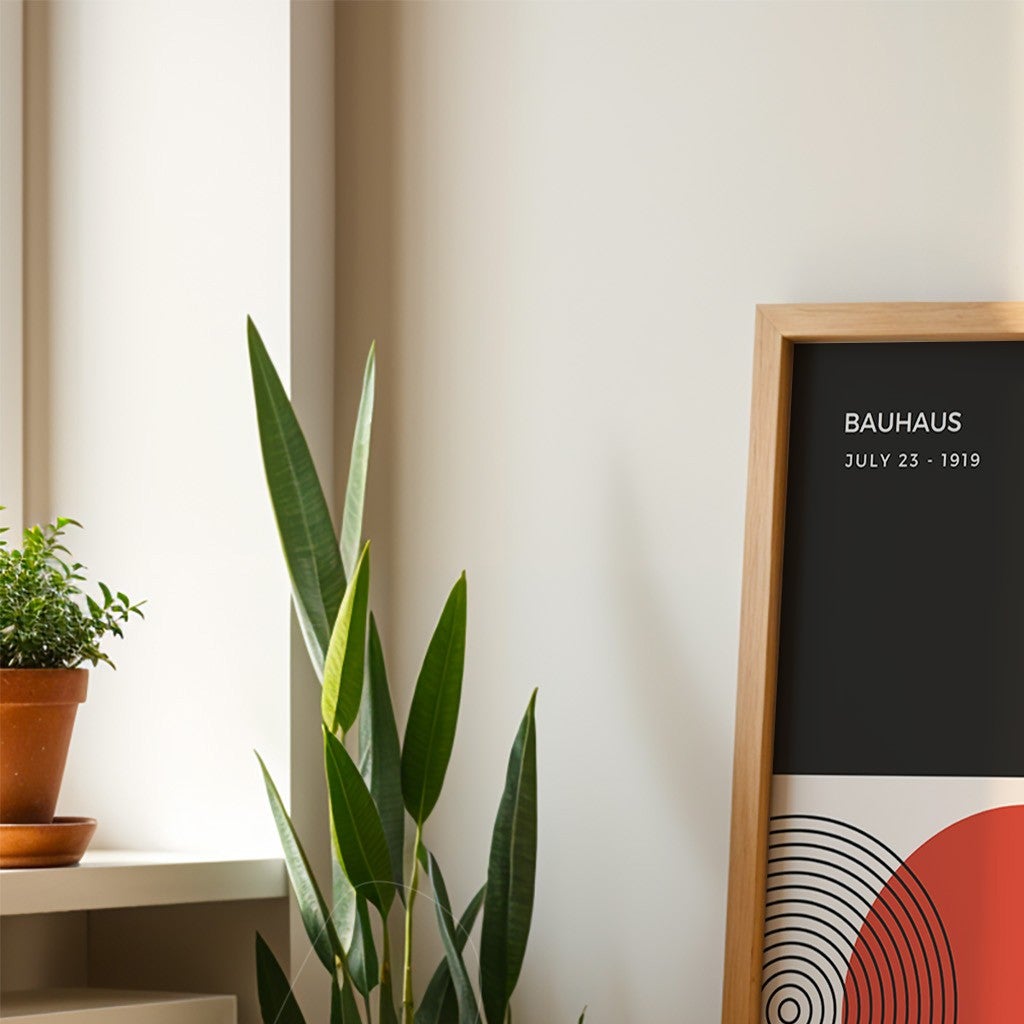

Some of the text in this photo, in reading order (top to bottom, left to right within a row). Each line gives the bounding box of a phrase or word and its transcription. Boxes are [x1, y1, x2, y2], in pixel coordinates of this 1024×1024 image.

[844, 411, 962, 433] BAUHAUS
[844, 453, 891, 468] JULY
[898, 453, 919, 468] 23
[941, 452, 981, 467] 1919
